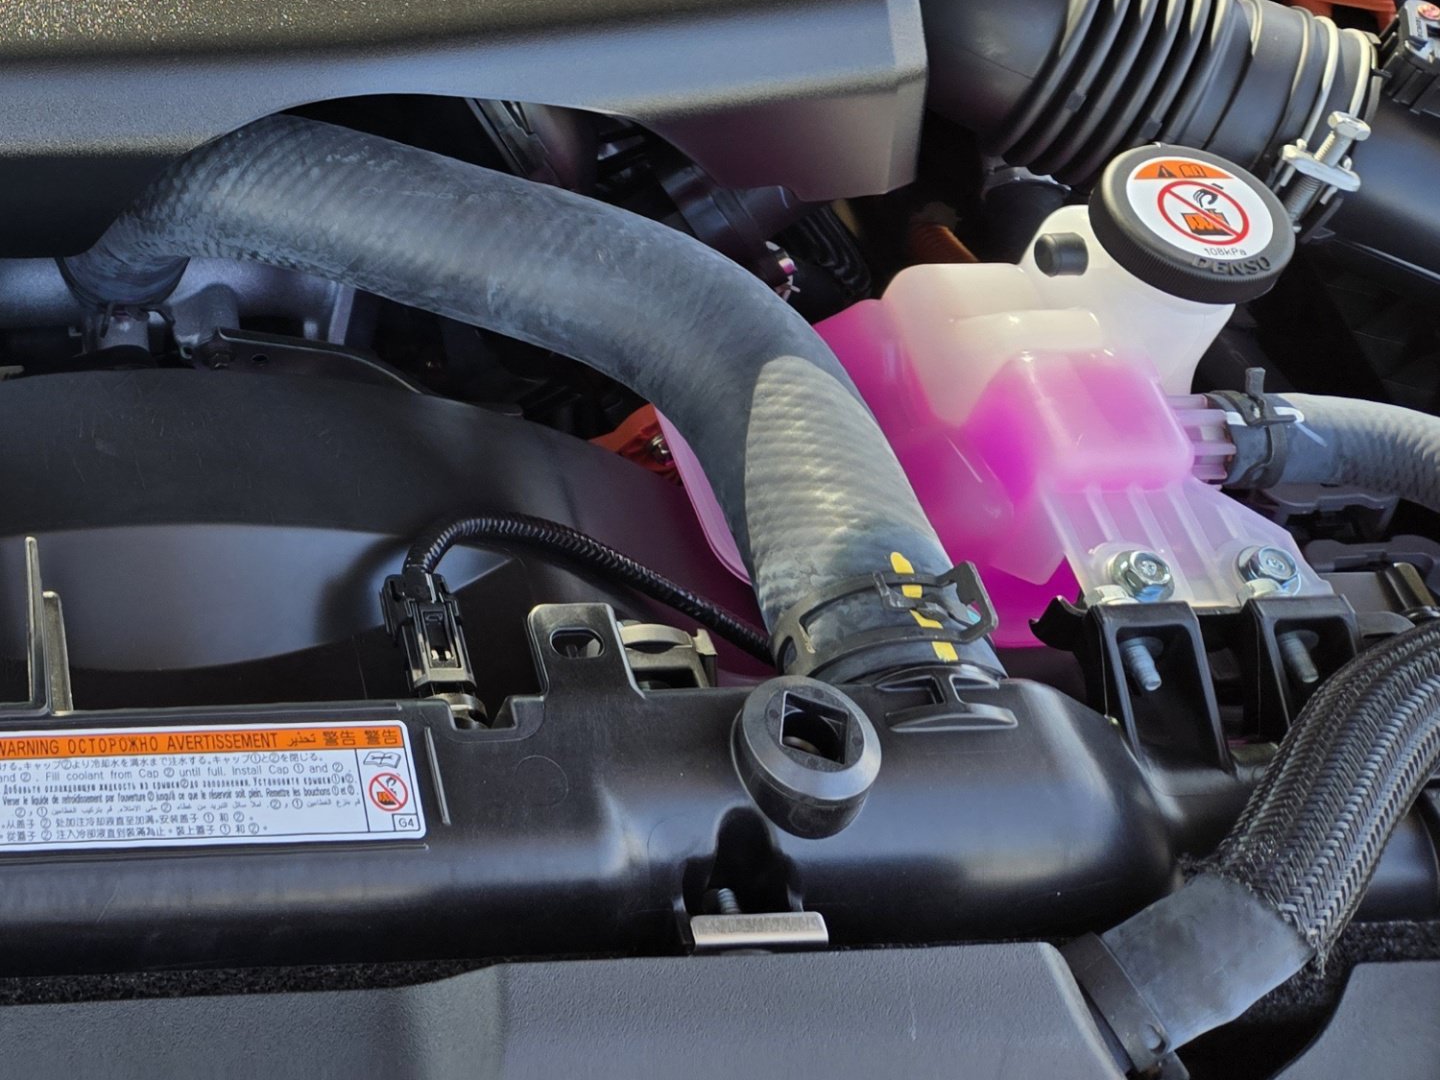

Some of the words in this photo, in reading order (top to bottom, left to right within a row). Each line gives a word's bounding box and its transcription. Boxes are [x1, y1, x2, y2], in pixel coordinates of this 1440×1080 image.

[1203, 247, 1247, 257] 108kPa
[1191, 256, 1271, 276] DENSO
[67, 736, 158, 753] ОСТОРОЖНО
[166, 732, 278, 750] AVERTISSEMENT
[323, 730, 356, 745] 警告
[364, 729, 398, 744] 警告
[45, 771, 59, 781] Fill
[66, 770, 103, 780] coolant
[110, 769, 131, 779] from
[138, 768, 159, 779] Cap
[179, 767, 200, 776] until
[207, 766, 225, 775] full.
[231, 765, 262, 775] Install
[268, 764, 289, 775] Cap
[308, 763, 328, 772] and
[397, 817, 414, 828] G4
